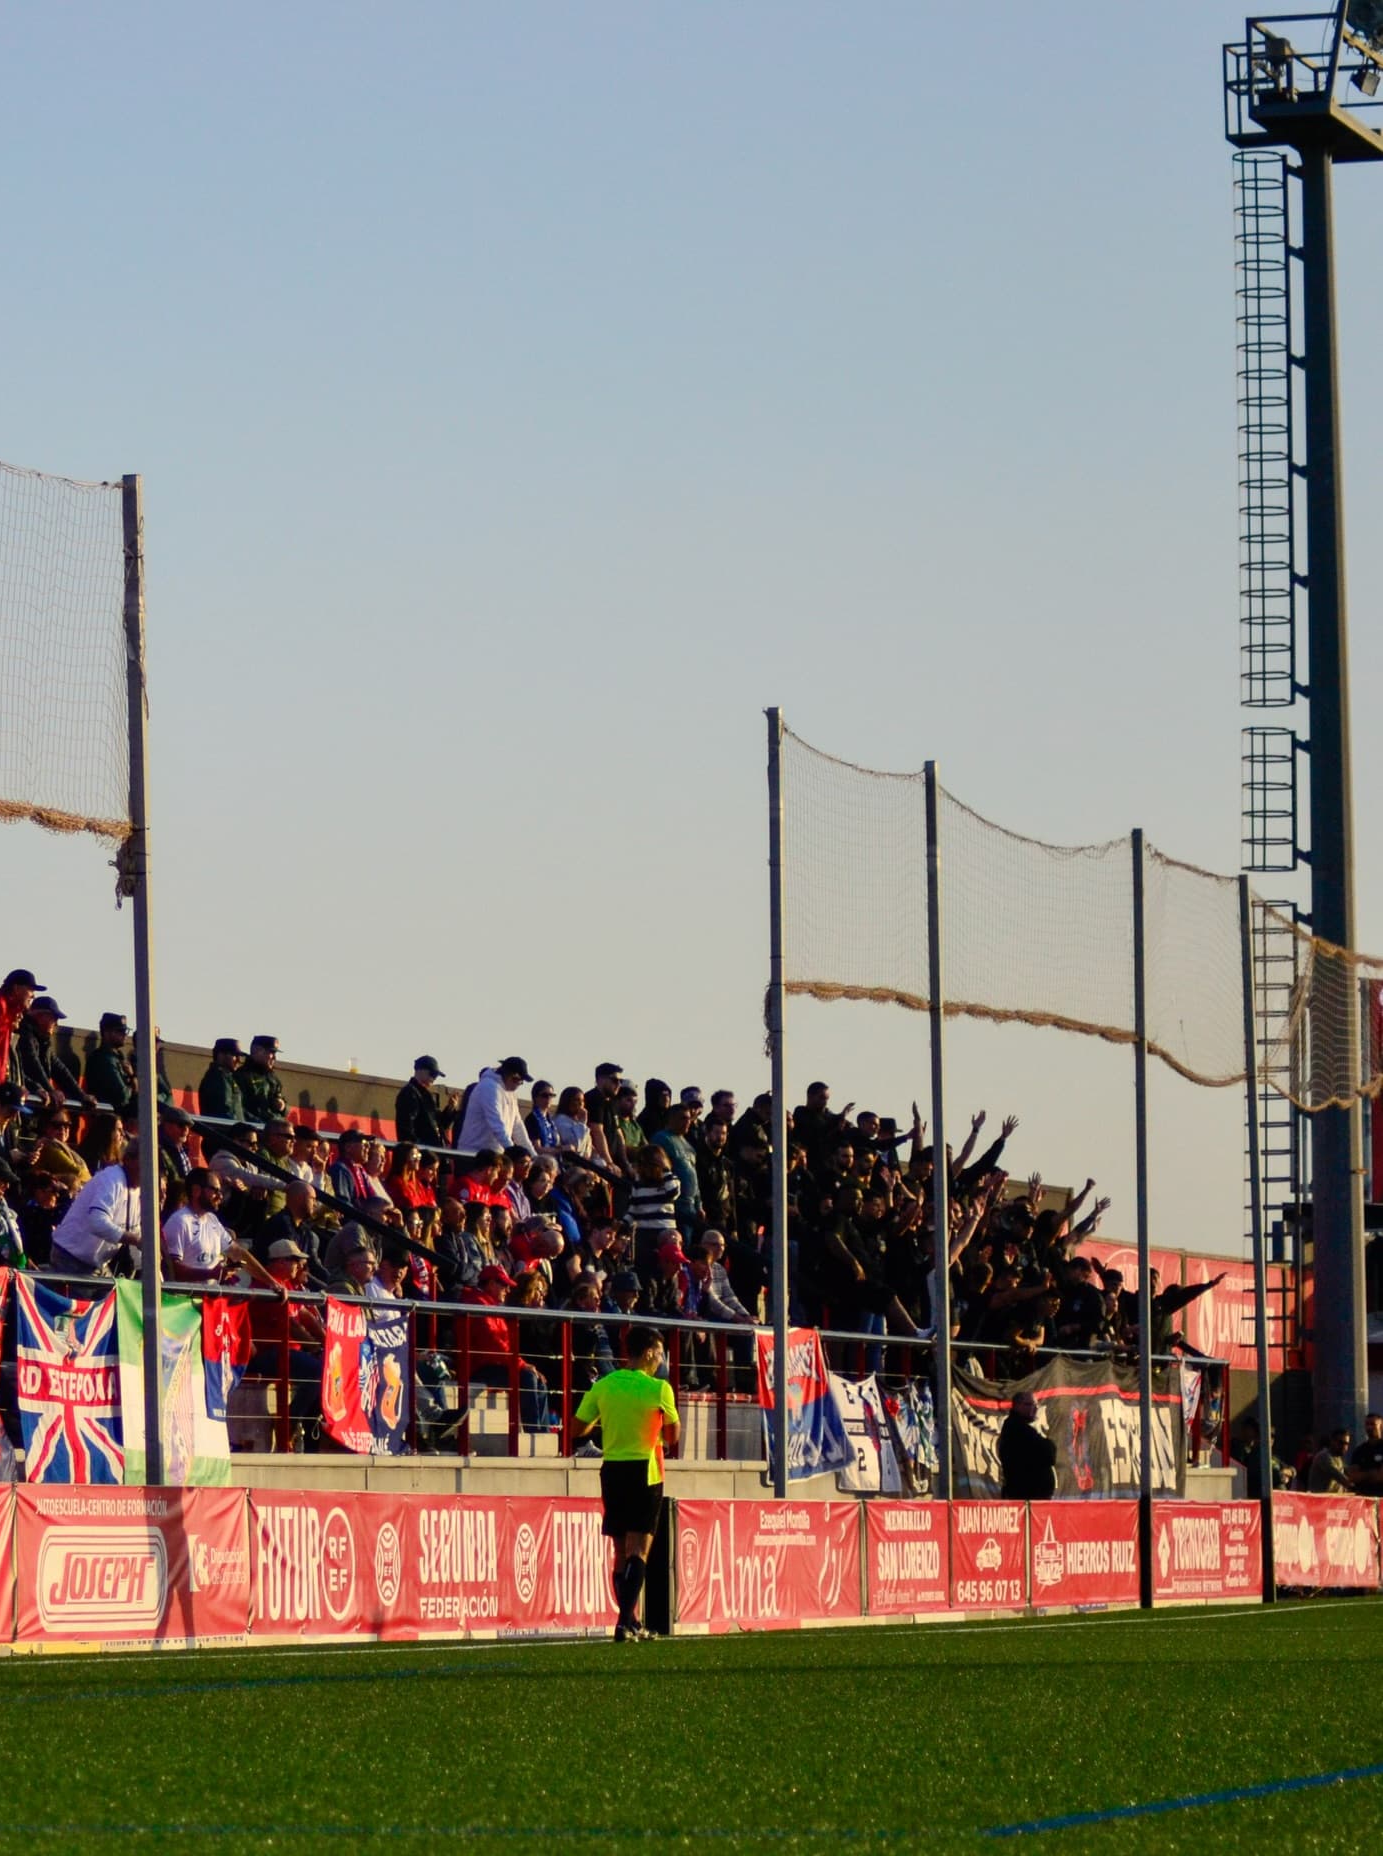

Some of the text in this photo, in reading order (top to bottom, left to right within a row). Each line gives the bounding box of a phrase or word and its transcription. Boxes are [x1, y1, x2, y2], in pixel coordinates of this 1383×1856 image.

[117, 1499, 127, 1516] DE
[884, 1510, 932, 1531] MEMBRILLO
[958, 1506, 1020, 1533] JUAN RAMIREZ
[328, 1536, 347, 1559] RF
[419, 1508, 498, 1584] SEGUNDA
[1066, 1541, 1136, 1575] HIERROS RUIZ
[706, 1503, 780, 1619] Alma
[878, 1541, 940, 1581] SAN LORENZO
[50, 1552, 157, 1605] JOSEPH
[329, 1569, 347, 1592] EF
[957, 1581, 978, 1602] 645
[979, 1581, 993, 1602] 96
[995, 1580, 1007, 1601] 07
[1009, 1579, 1021, 1601] 13
[419, 1588, 499, 1619] FEDERACIÓN
